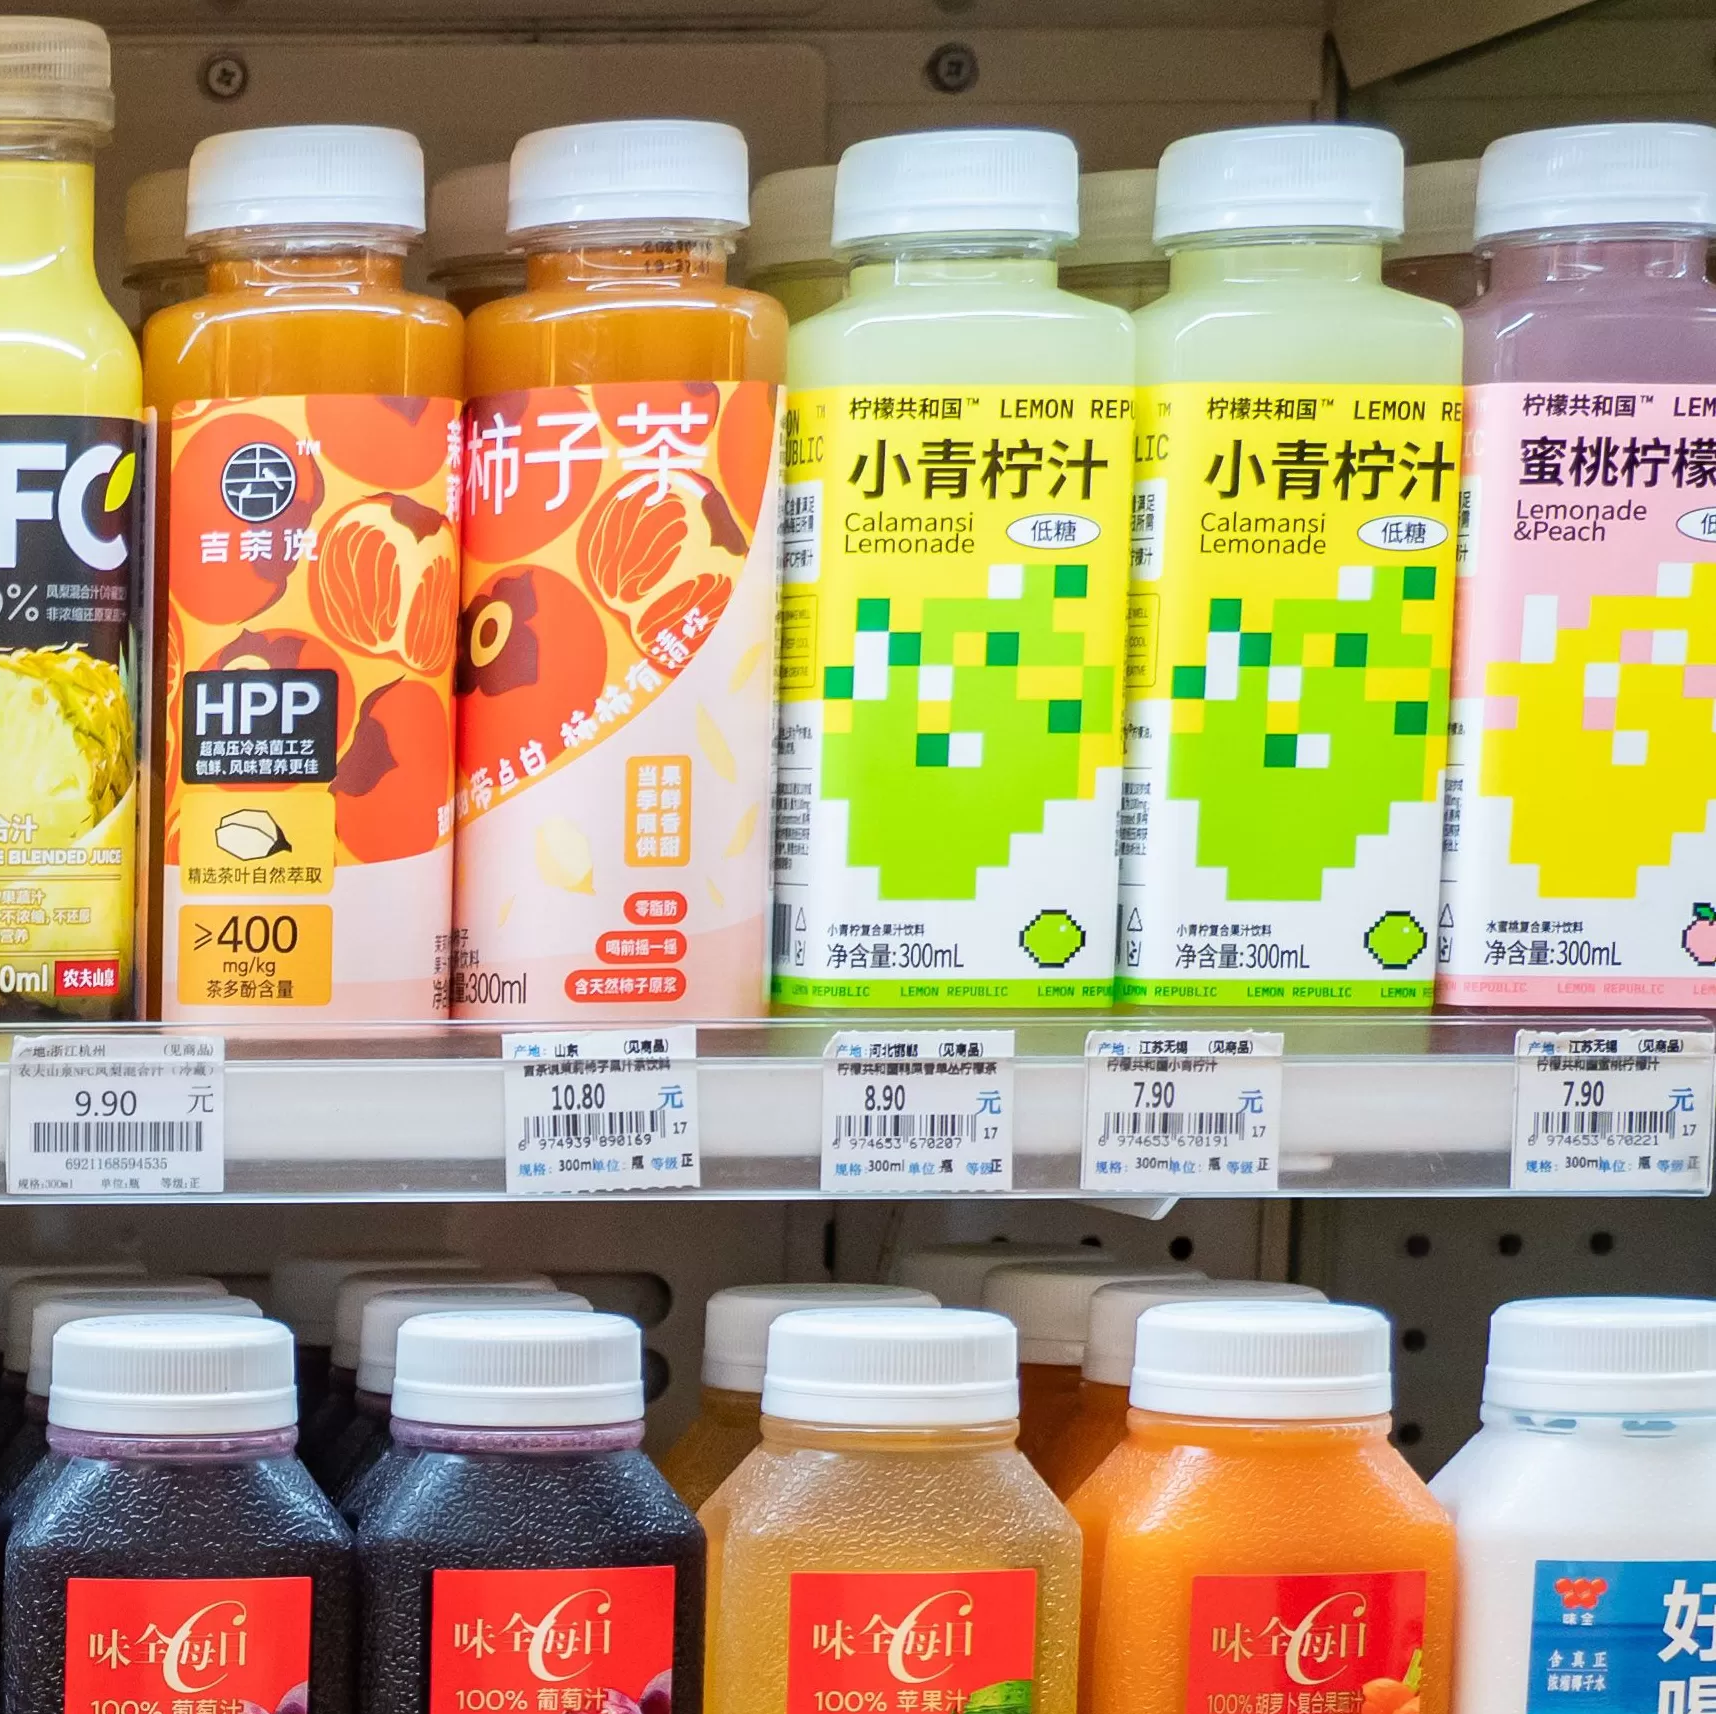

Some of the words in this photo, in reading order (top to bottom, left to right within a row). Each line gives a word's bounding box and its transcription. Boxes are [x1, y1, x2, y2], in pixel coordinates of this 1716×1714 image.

[467, 402, 709, 517] 柿子茶
[848, 438, 1109, 501] 小青柠汁
[1206, 438, 1455, 502] 小青柠汁
[1515, 500, 1647, 521] Lemonade
[845, 512, 974, 533] Calamansi
[1031, 520, 1077, 543] 低糖
[1201, 512, 1325, 534] Calamansi
[1381, 521, 1427, 545] 低糖
[1513, 522, 1606, 543] &Peach
[845, 534, 975, 555] Lemonade
[1200, 535, 1326, 555] Lemonade
[196, 682, 321, 737] HPP
[200, 740, 314, 756] 超高压冷杀菌工艺
[9, 849, 85, 865] BLENDED
[90, 848, 121, 865] JUICE
[188, 866, 322, 885] 精选茶叶自然萃取
[635, 901, 678, 917] 零脂肪
[606, 940, 677, 955] 喝前摇一摇
[223, 957, 275, 976] mg/kg
[206, 980, 293, 1000] 茶多酚含量
[575, 977, 677, 995] 含天然柿子原浆
[901, 986, 939, 998] LEMON
[947, 986, 1008, 997] REPUBLIC
[75, 1091, 137, 1118] 9.90
[187, 1086, 214, 1114] 元
[552, 1083, 605, 1110] 10.80
[658, 1085, 684, 1110] 元
[865, 1085, 905, 1112] 8.90
[977, 1090, 1002, 1115] 元
[1134, 1082, 1175, 1109] 7.90
[1237, 1090, 1263, 1115] 元
[1563, 1080, 1604, 1109] 7.90
[1667, 1089, 1695, 1114] 元
[815, 1691, 887, 1713] 100%
[897, 1690, 967, 1714] 苹果汁
[1208, 1693, 1253, 1714] 100%
